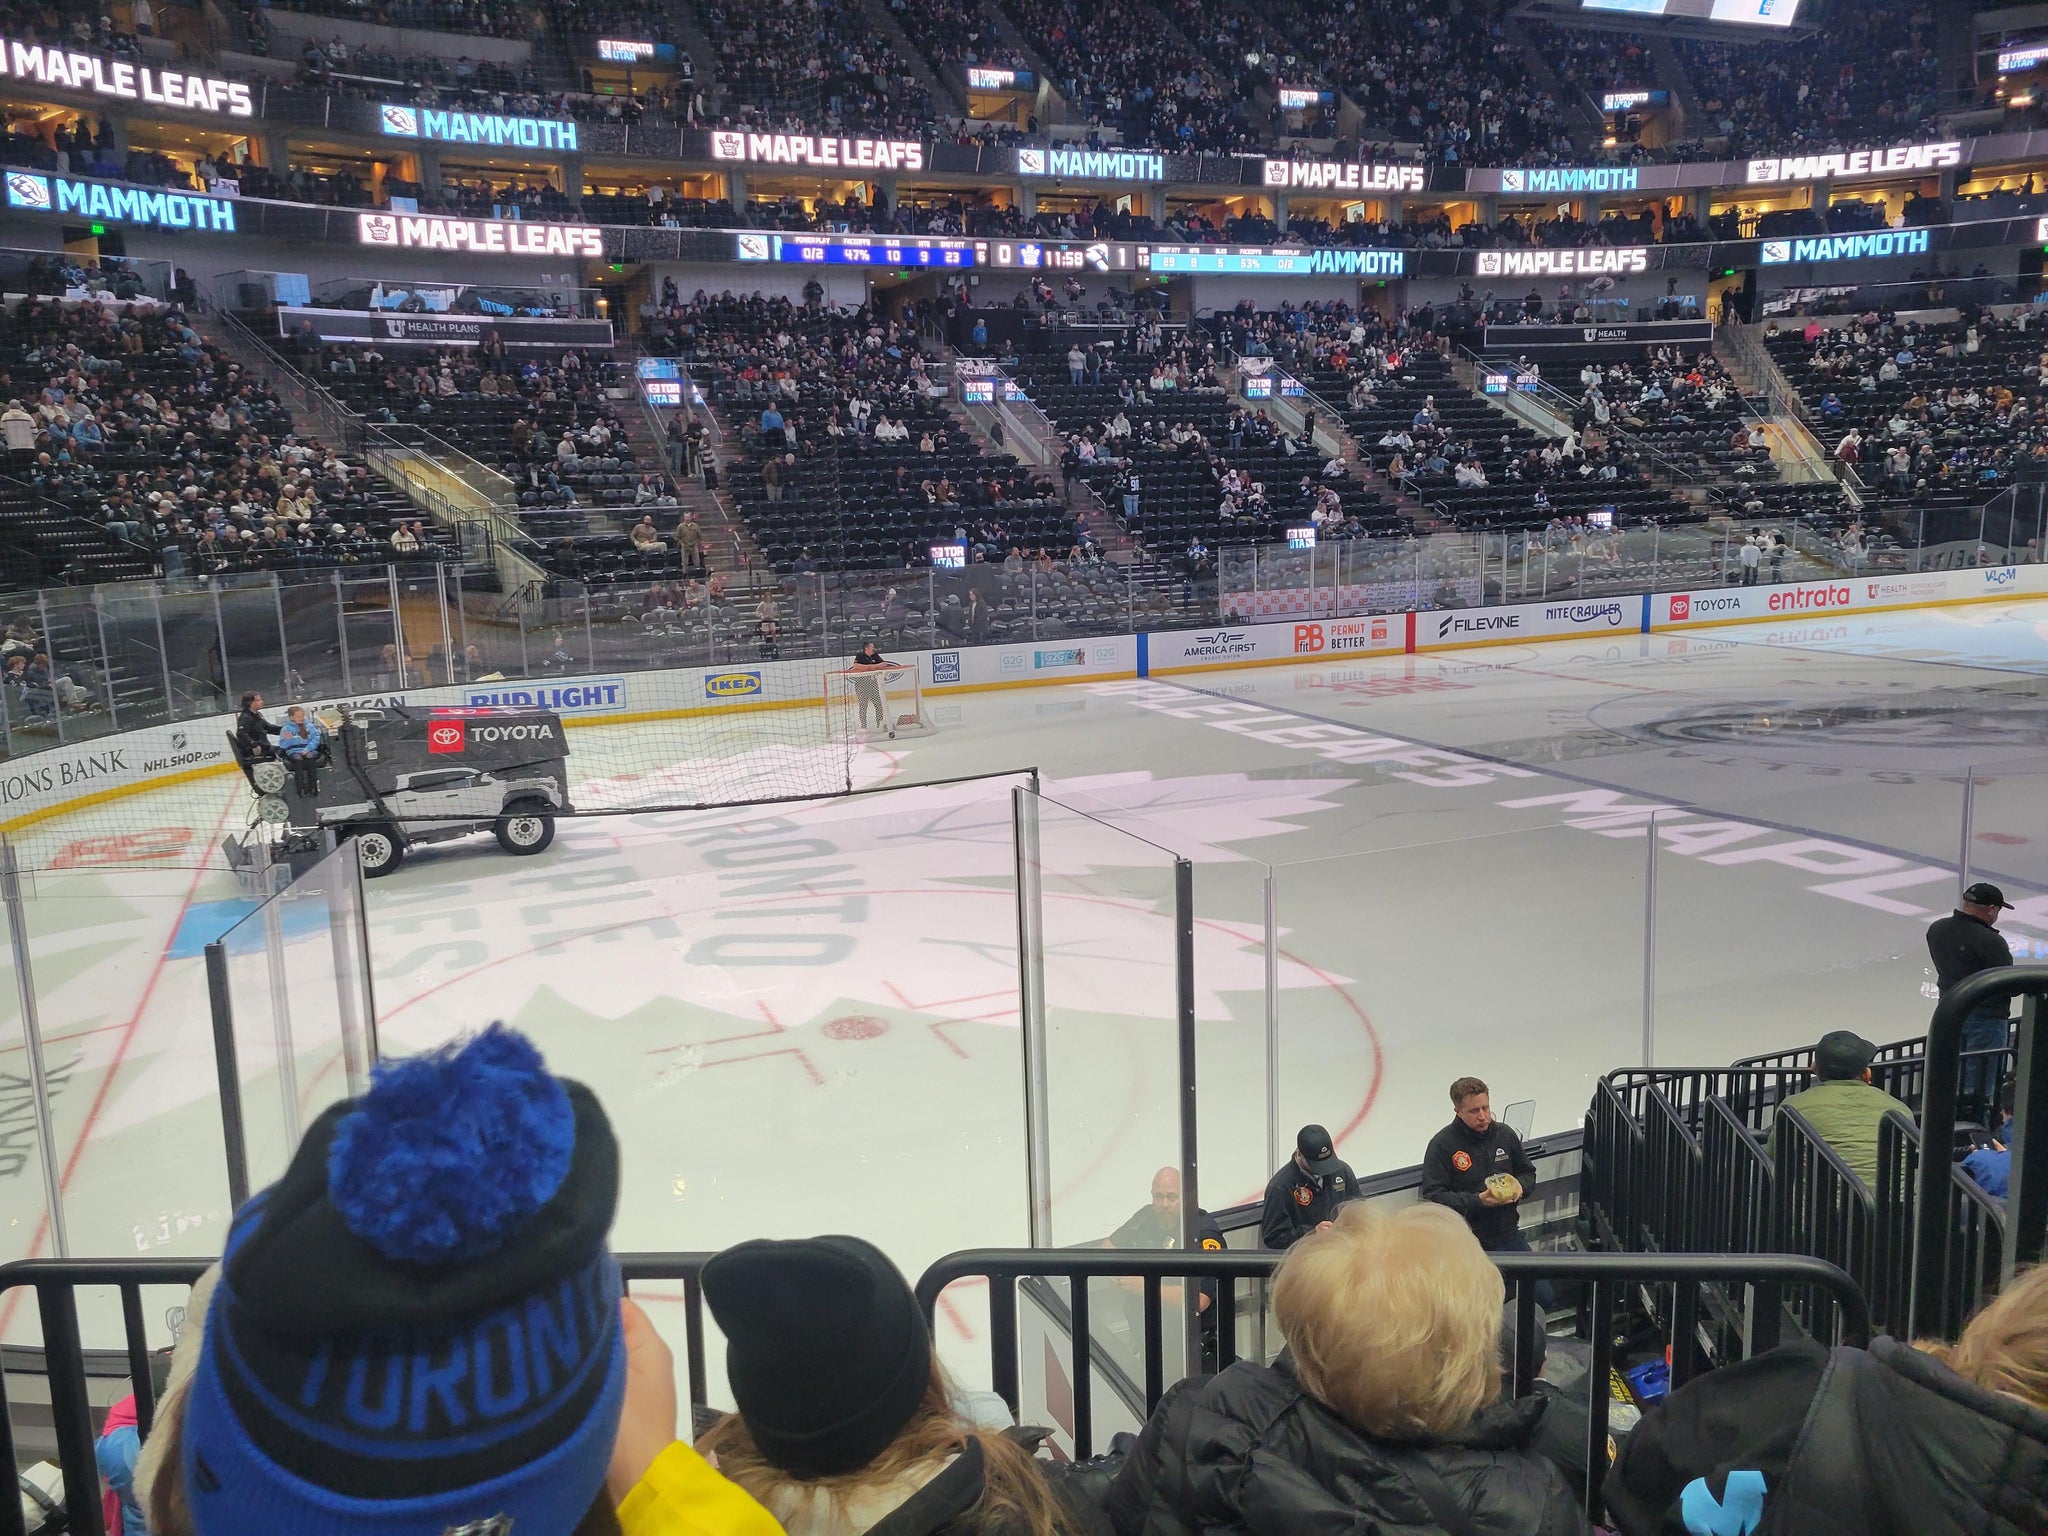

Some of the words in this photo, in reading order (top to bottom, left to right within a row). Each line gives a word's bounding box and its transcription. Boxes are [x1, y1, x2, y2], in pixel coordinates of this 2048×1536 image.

[611, 41, 653, 54] TORONTO
[612, 50, 636, 60] UTAH
[2010, 59, 2034, 68] UTAH
[11, 42, 136, 97] MAPLE
[140, 67, 252, 116] LEAFS
[979, 70, 1014, 81] TORONTO
[980, 79, 999, 88] UTAH
[1288, 90, 1318, 100] TORONTO
[1614, 92, 1648, 101] TORONTO
[422, 109, 578, 150] MAMMOTH
[750, 133, 839, 165] MAPLE
[843, 139, 922, 169] LEAFS
[1050, 150, 1163, 179] MAMMOTH
[1780, 151, 1870, 179] MAPLE
[1870, 142, 1961, 172] LEAFS
[1292, 161, 1359, 188] MAPLE
[1362, 165, 1424, 190] LEAFS
[1528, 168, 1638, 191] MAMMOTH
[56, 178, 235, 231] MAMMOTH
[402, 217, 505, 252] MAPLE
[509, 224, 602, 256] LEAFS
[1795, 231, 1929, 261] MAMMOTH
[803, 248, 823, 259] 0/2
[844, 249, 870, 261] 47%
[887, 250, 900, 261] 10
[920, 251, 928, 262] 9
[945, 252, 960, 263] 23
[978, 251, 985, 262] 6
[999, 244, 1012, 263] 0
[1045, 251, 1083, 266] 11:58
[1118, 248, 1126, 266] 1
[1139, 255, 1149, 266] 12
[1163, 257, 1175, 267] 29
[1240, 259, 1260, 269] 53%
[1278, 259, 1293, 269] 0/2
[1310, 251, 1403, 273] MAMMOTH
[1504, 251, 1574, 274] MAPLE
[1577, 249, 1647, 272] LEAFS
[408, 322, 446, 332] HEALTH
[449, 324, 480, 333] PLANS
[1598, 330, 1627, 338] HEALTH
[660, 383, 680, 394] TOR
[977, 383, 993, 392] TOR
[1256, 379, 1271, 387] TOR
[1248, 388, 1262, 397] UTA
[1298, 528, 1315, 538] TOR
[1289, 539, 1305, 549] UTA
[944, 546, 964, 557] TOR
[1985, 568, 2016, 584] VLCM
[1881, 584, 1908, 594] HEALTH
[1769, 584, 1850, 612] entrata
[1694, 597, 1741, 612] TOYOTA
[1454, 615, 1520, 632] FILEVINE
[1331, 623, 1366, 636] PEANUT
[1299, 641, 1309, 653] fit
[1331, 637, 1366, 649] BETTER
[1096, 648, 1115, 657] G2G
[1184, 645, 1227, 657] AMERICA
[1229, 643, 1257, 653] FIRST
[935, 655, 957, 664] BUILT
[1003, 656, 1023, 665] G2G
[1046, 653, 1064, 661] G2G
[935, 672, 958, 680] TOUGH
[711, 679, 758, 690] IKEA
[536, 685, 619, 708] LIGHT
[471, 724, 554, 742] TOYOTA
[0, 767, 52, 804] IONS
[59, 749, 129, 786] BANK
